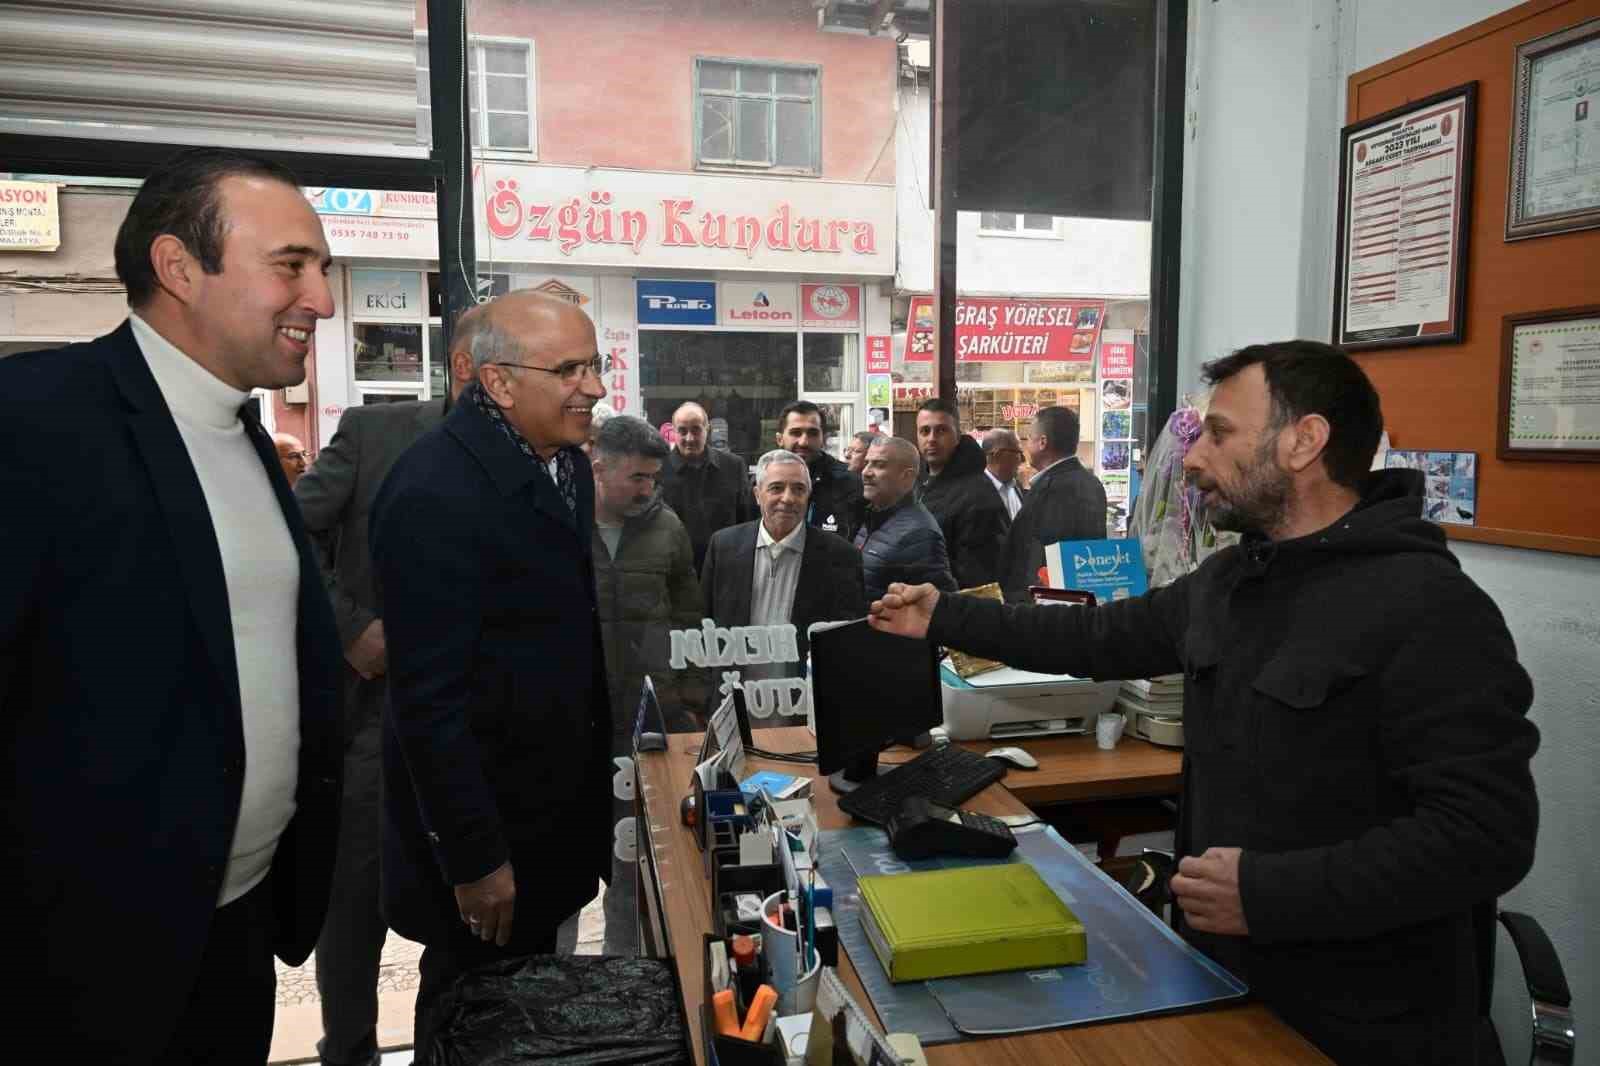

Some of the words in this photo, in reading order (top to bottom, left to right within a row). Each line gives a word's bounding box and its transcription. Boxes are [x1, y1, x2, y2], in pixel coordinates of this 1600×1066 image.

[486, 179, 649, 255] Özgün
[659, 198, 878, 260] Kundura
[956, 302, 998, 330] ĞRAŞ
[1004, 303, 1073, 326] YÖRESEL
[959, 331, 1049, 359] ŞARKÜTERİ
